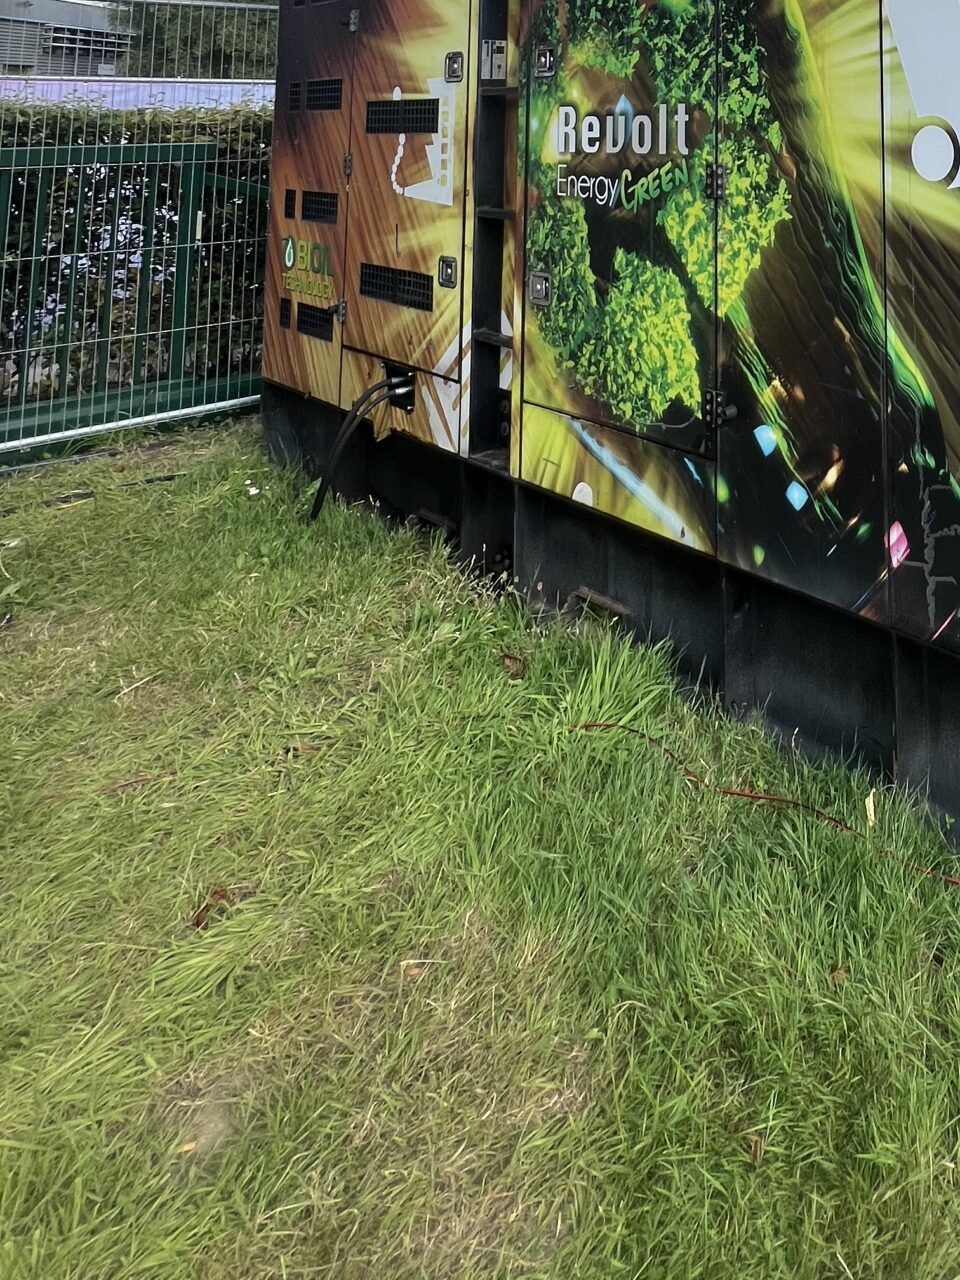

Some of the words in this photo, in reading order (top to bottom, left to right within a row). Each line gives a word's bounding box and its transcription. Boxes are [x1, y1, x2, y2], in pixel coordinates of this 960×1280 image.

[557, 103, 689, 156] Revolt
[557, 164, 619, 207] Energy
[620, 158, 689, 214] GREEN
[282, 272, 334, 299] TECHNOLOGY
